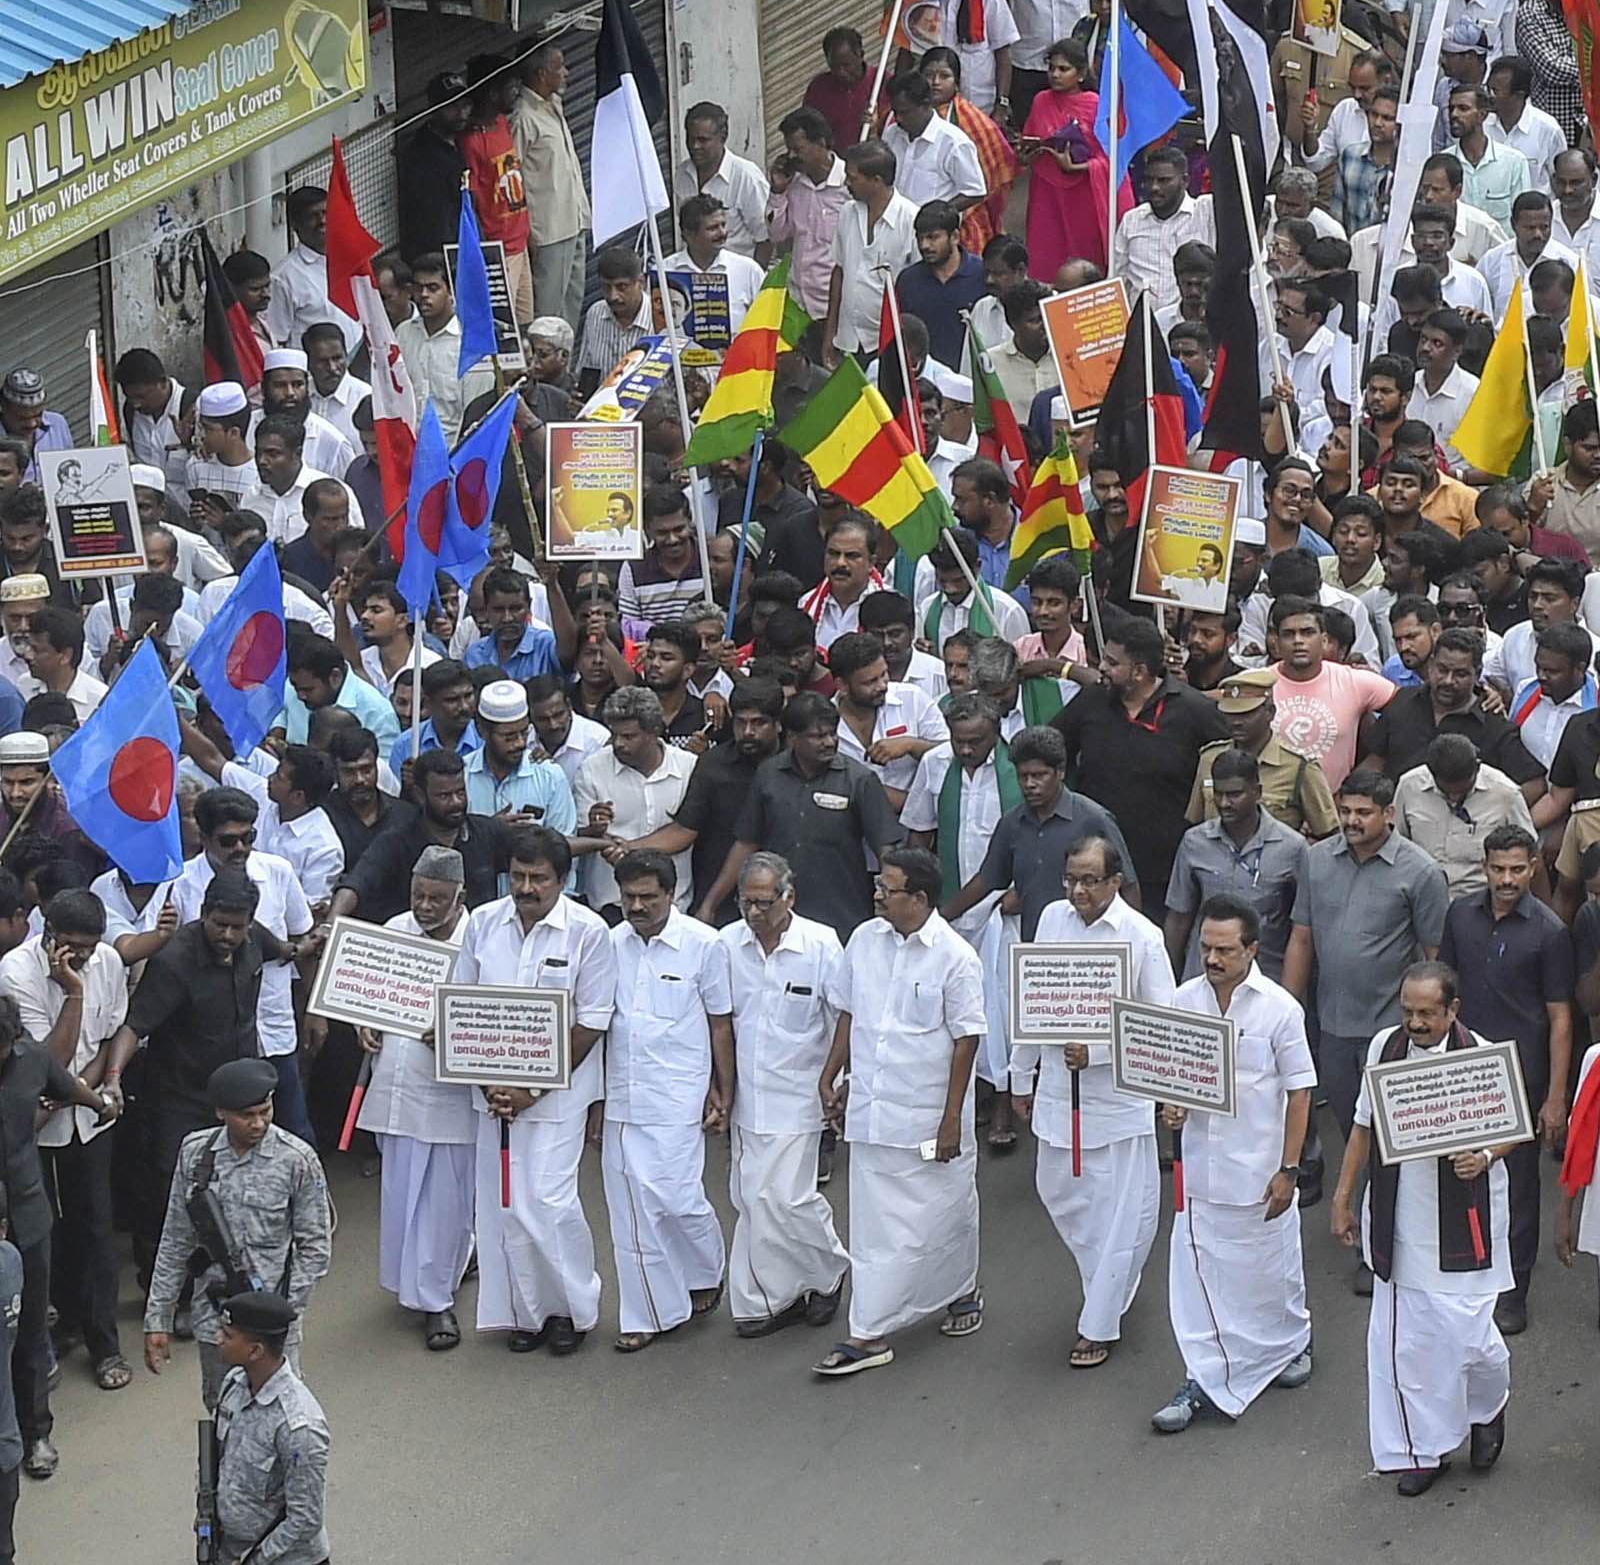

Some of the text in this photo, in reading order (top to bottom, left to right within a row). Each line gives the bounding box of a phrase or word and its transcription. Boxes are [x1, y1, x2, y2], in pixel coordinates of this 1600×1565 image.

[173, 49, 218, 119] Seat
[219, 26, 280, 94] Cover
[6, 83, 282, 240] All Two Wheller Seat Covers & Tank Covers
[334, 980, 430, 1011] மாபெரும் பேரணி
[1026, 1004, 1074, 1017] மாபெரும்
[453, 1045, 550, 1059] மாபெரும் பேரணி
[1128, 1059, 1217, 1086] மாபெரும் பேரணி
[1397, 1103, 1506, 1132] மாபெரும் பேரணி
